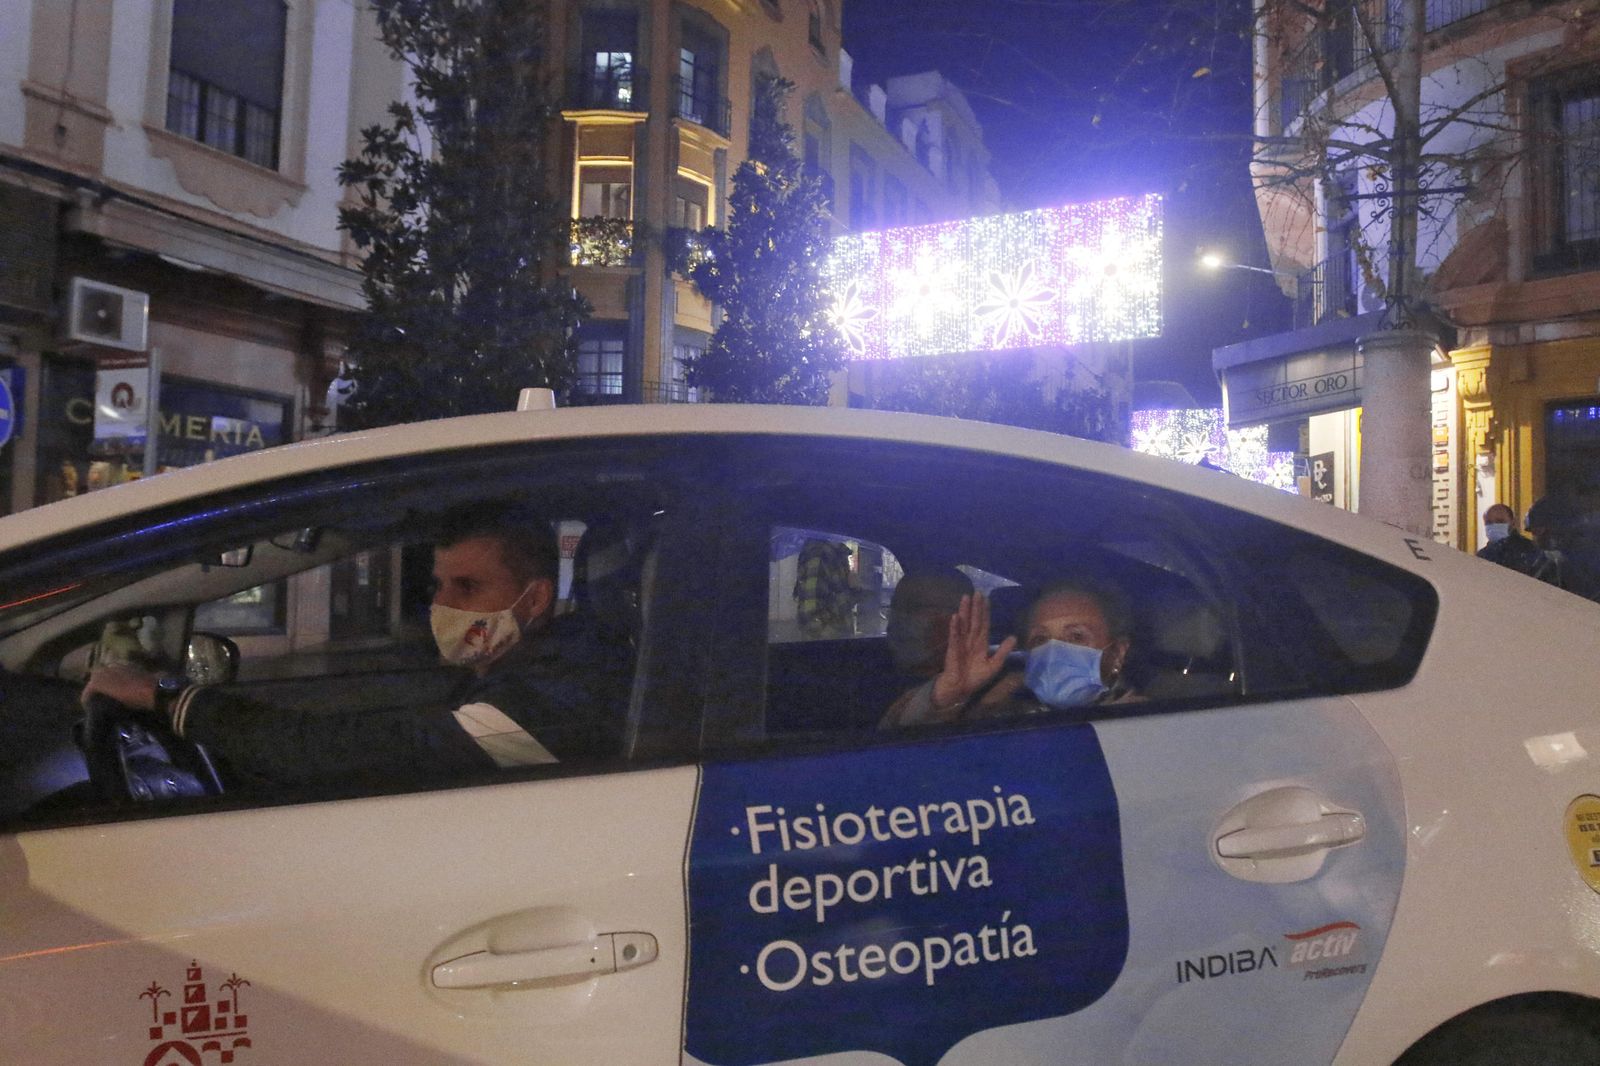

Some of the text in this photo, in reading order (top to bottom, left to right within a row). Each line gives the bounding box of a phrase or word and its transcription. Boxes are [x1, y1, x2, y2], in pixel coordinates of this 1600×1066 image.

[1256, 374, 1348, 402] SECTOR ORO
[745, 785, 1036, 854] Fisioterapia
[748, 849, 993, 923] deportiva
[756, 910, 1038, 992] Osteopatía
[1176, 946, 1279, 983] INDIBA
